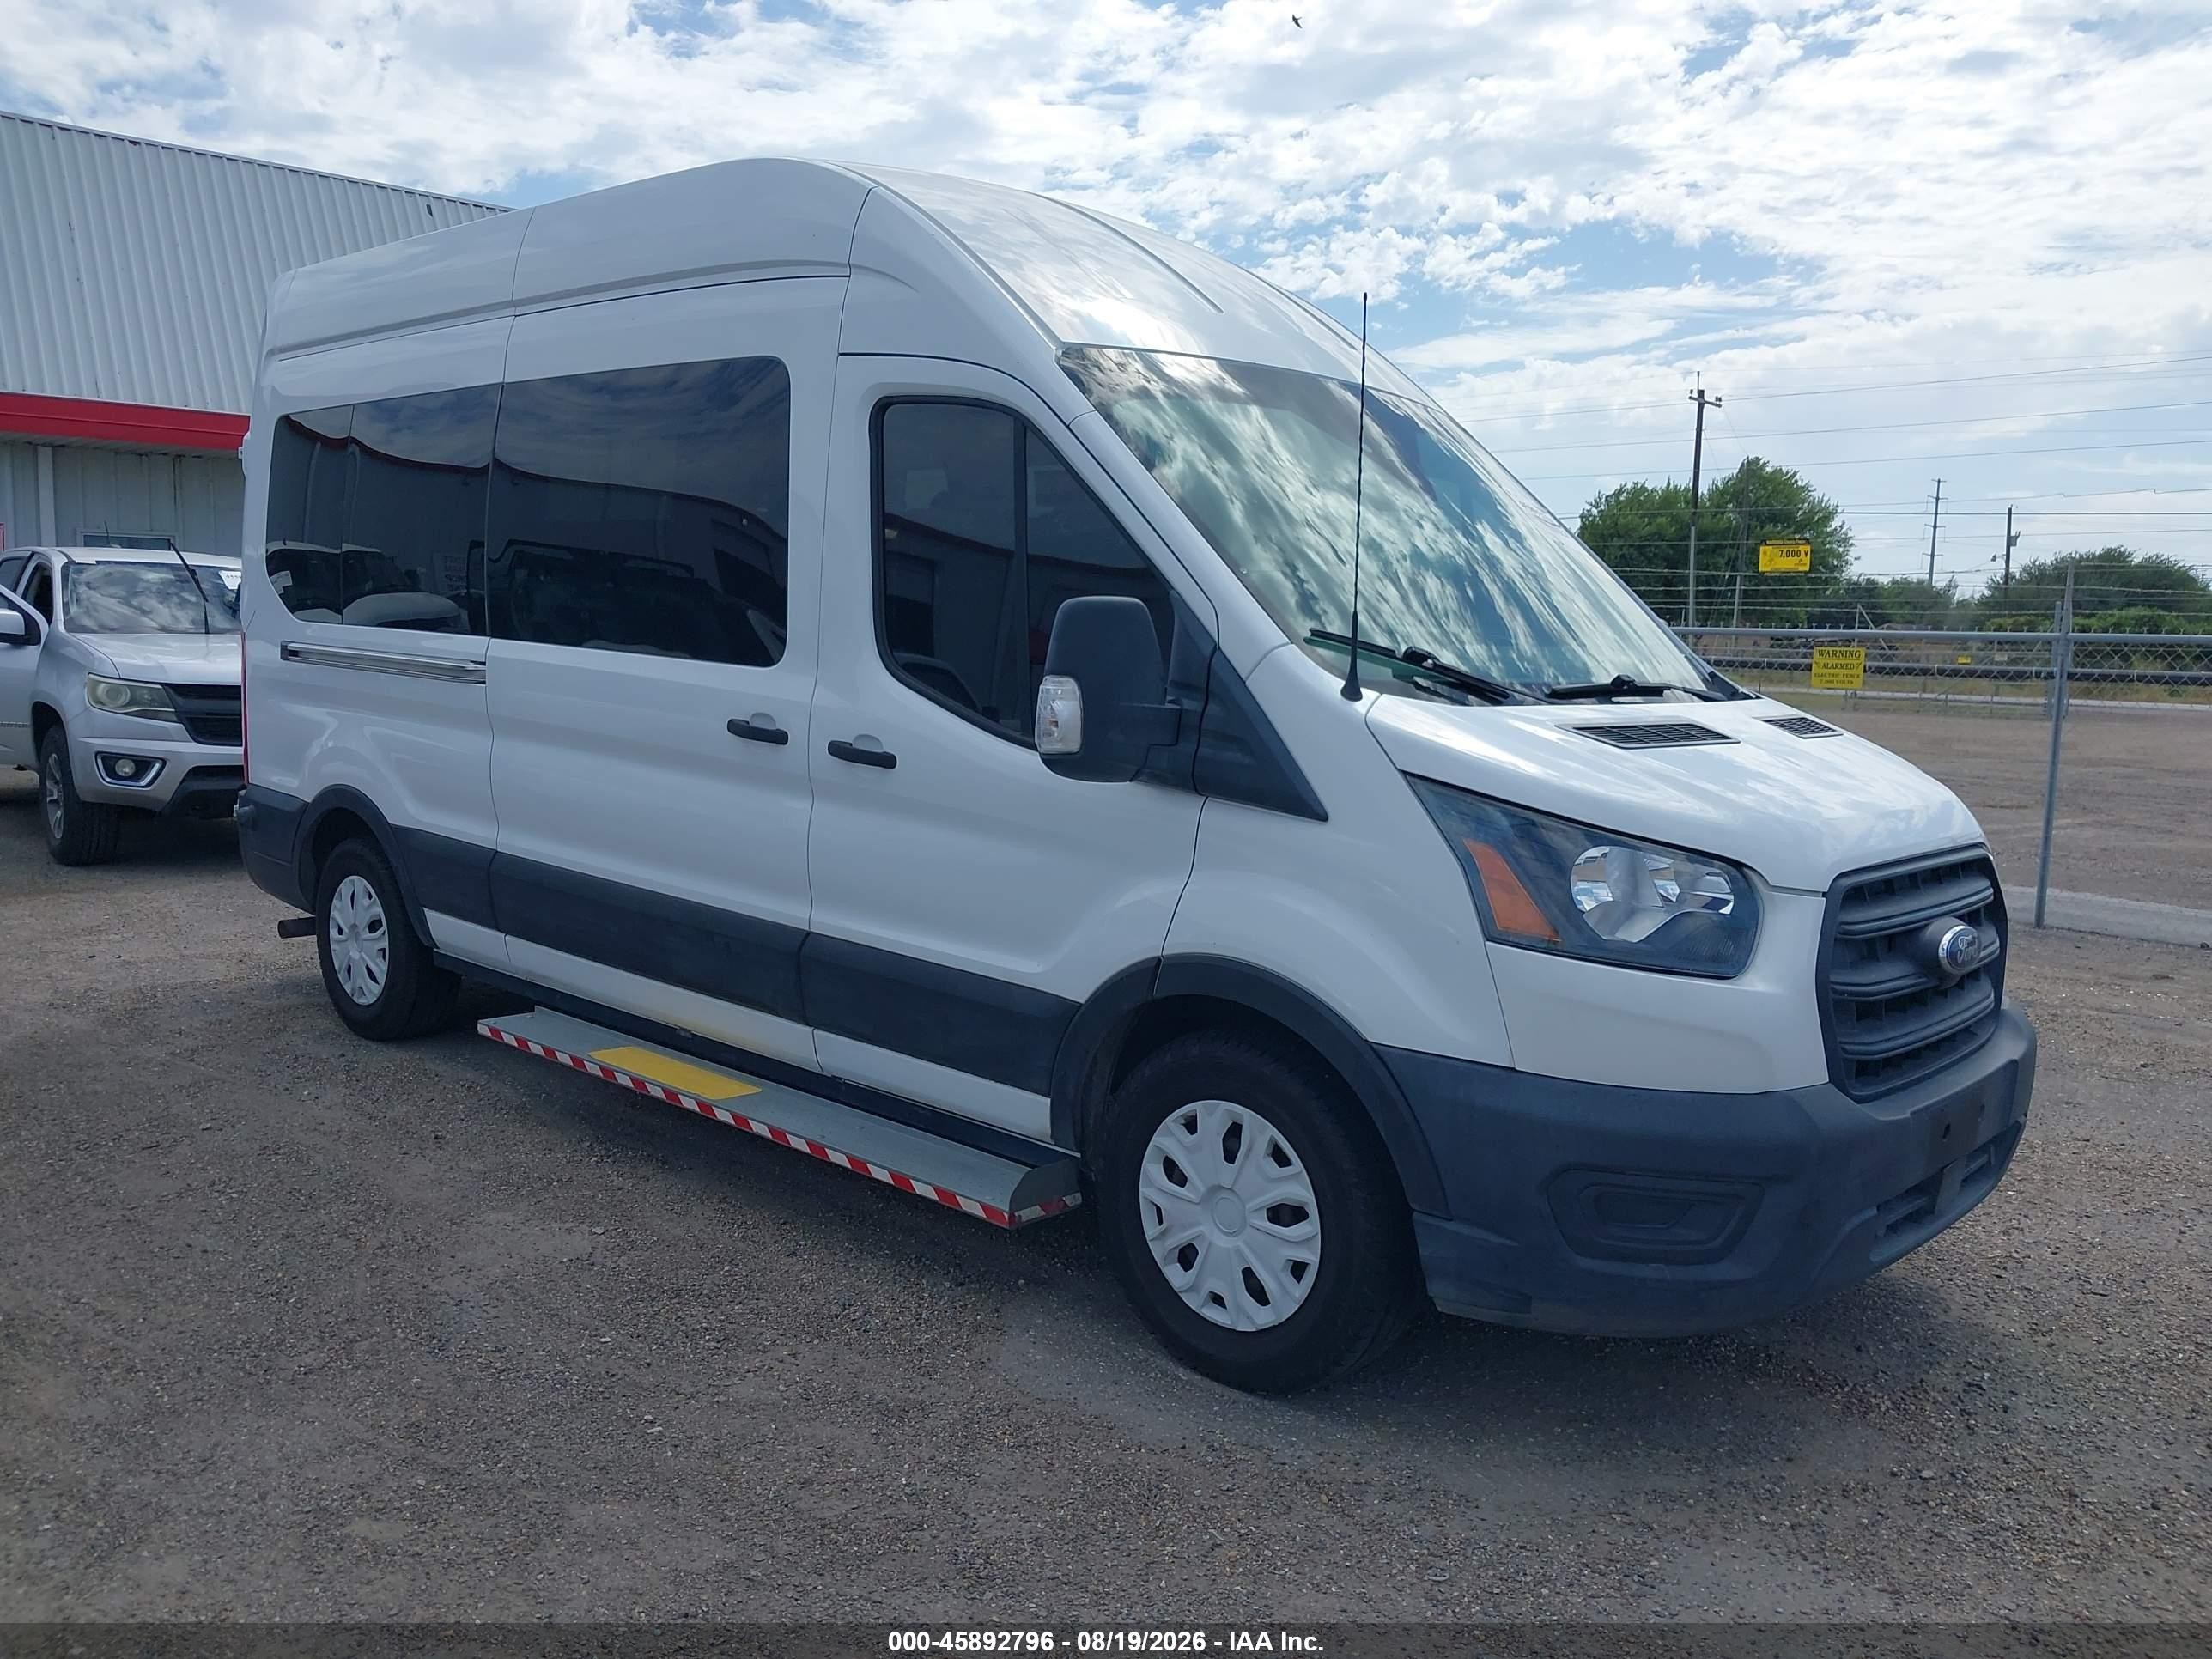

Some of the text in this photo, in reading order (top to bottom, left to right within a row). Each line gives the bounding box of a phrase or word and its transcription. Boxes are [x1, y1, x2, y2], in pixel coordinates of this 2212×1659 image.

[1778, 549, 1809, 559] 7,000 V
[1818, 649, 1862, 659] WARNING
[1957, 934, 1978, 963] Ford
